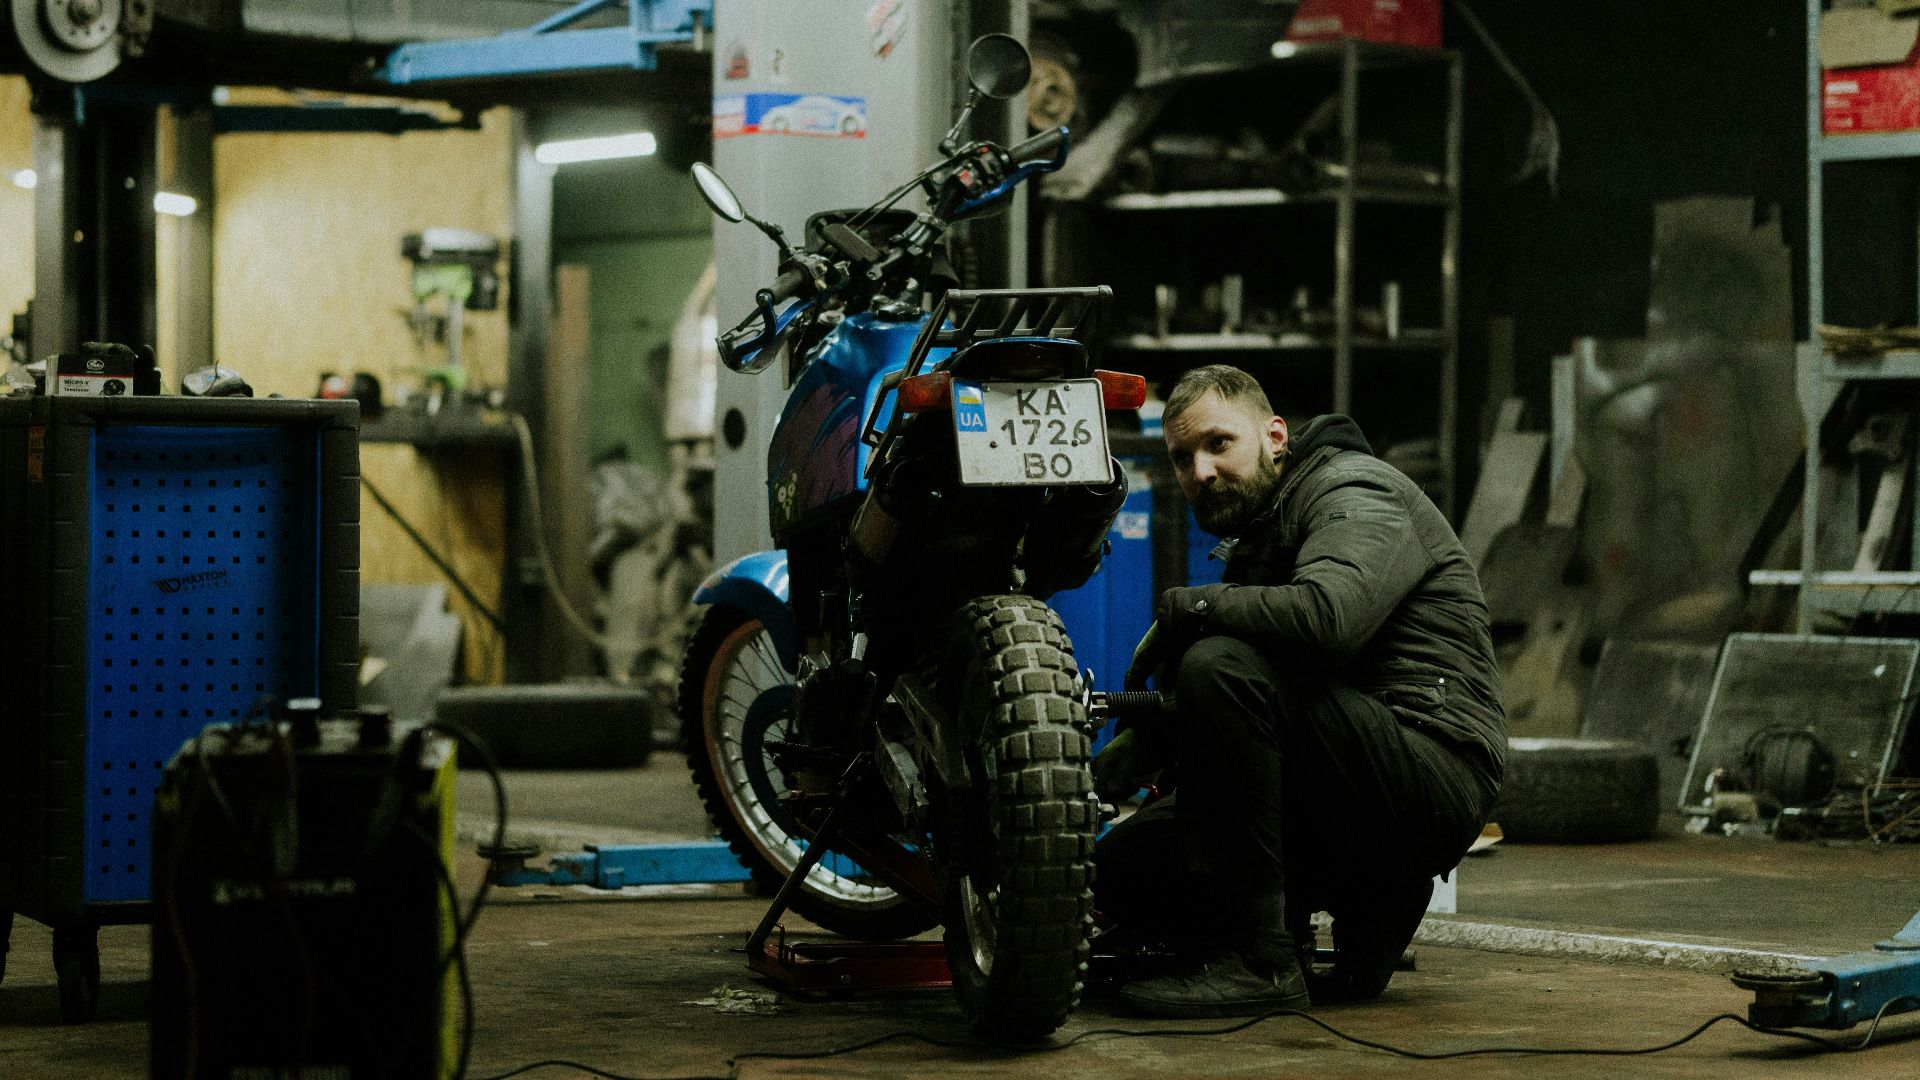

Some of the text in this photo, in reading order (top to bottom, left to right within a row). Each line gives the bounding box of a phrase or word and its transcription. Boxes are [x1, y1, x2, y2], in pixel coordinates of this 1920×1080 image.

[1016, 388, 1067, 416] KA
[960, 412, 984, 427] UA
[1001, 418, 1092, 446] 1726
[1023, 452, 1072, 479] BO
[182, 568, 227, 585] MAXTON
